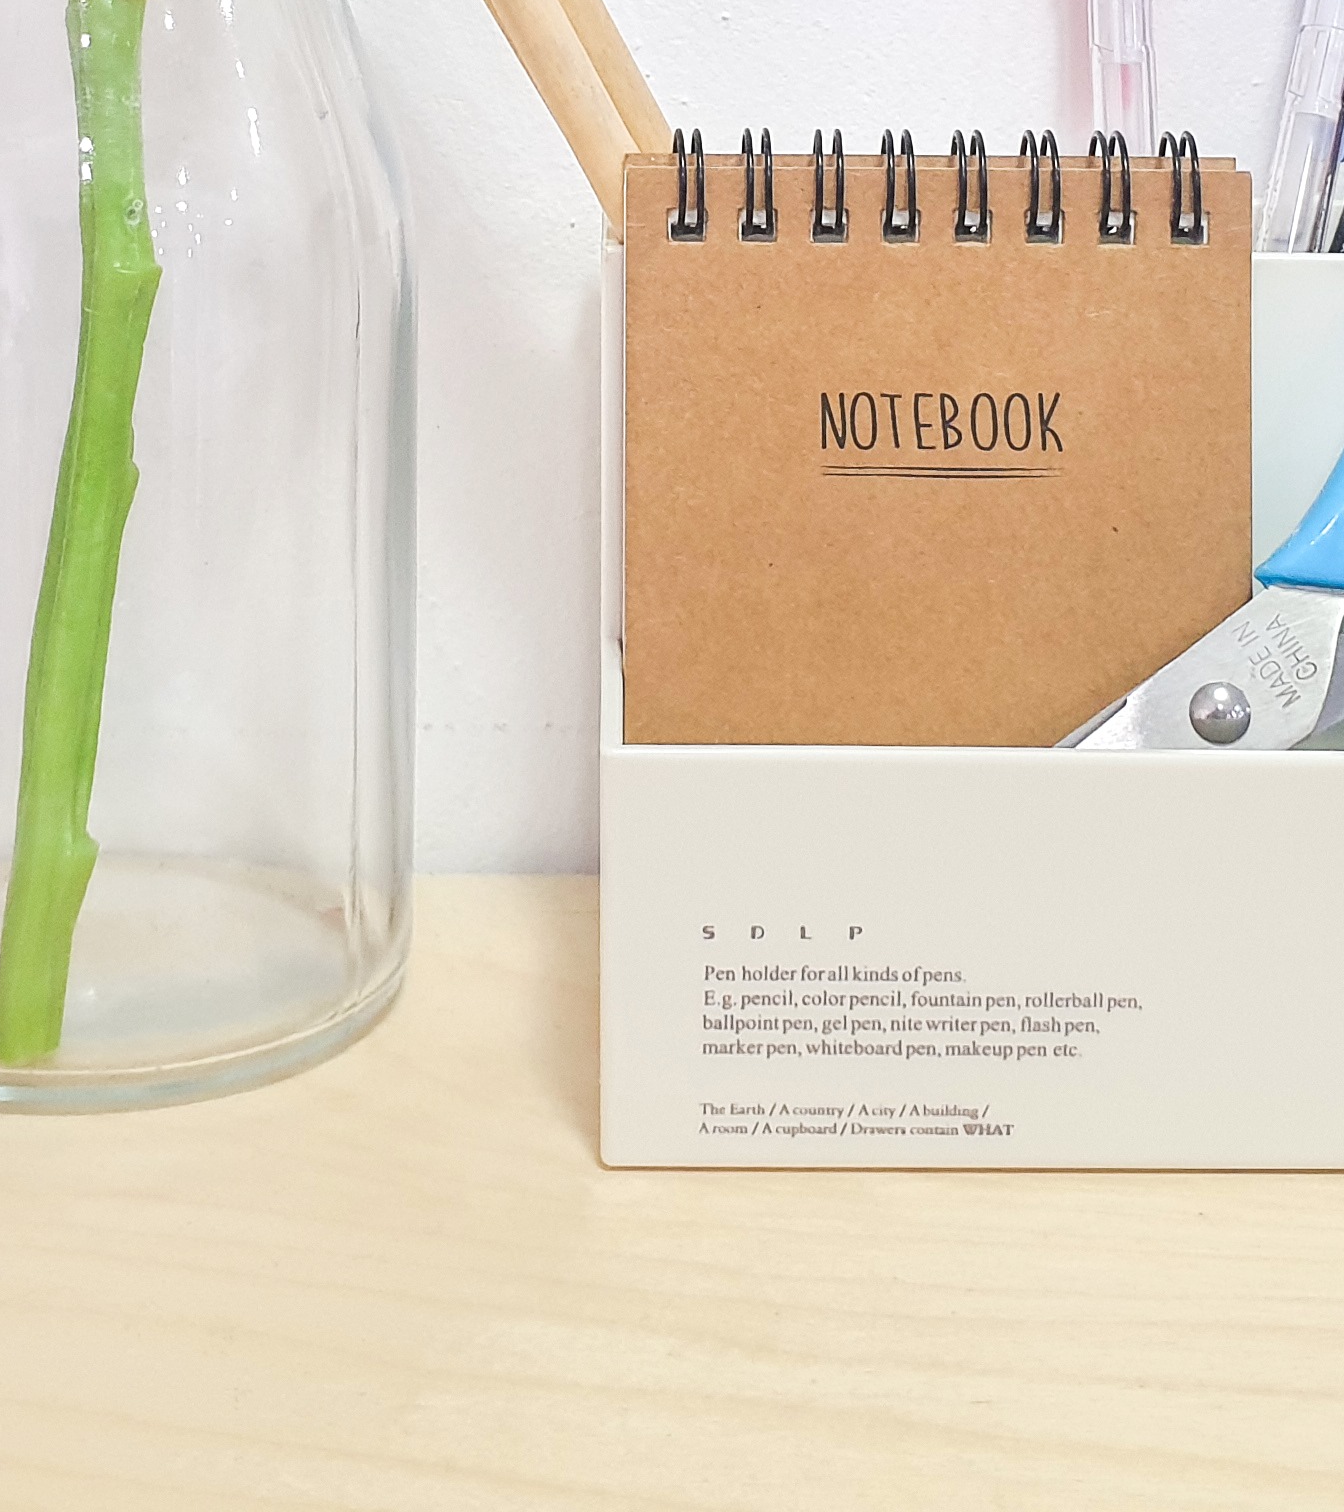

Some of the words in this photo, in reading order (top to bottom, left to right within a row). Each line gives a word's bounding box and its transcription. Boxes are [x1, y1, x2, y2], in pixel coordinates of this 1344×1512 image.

[820, 391, 1064, 453] NOTEBOOK
[1231, 620, 1261, 648] IN
[1264, 612, 1318, 681] CHINA
[1247, 644, 1302, 709] MADE
[703, 964, 736, 982] Pen
[741, 964, 798, 982] holder
[800, 964, 826, 982] for
[827, 965, 849, 982] all
[852, 965, 899, 983] kinds
[901, 965, 923, 983] of
[703, 989, 737, 1011] E.g.
[740, 989, 799, 1011] pencil,
[801, 989, 847, 1007] color
[849, 989, 907, 1011] pencil,
[910, 990, 982, 1008] fountain
[985, 995, 1022, 1012] pen,
[1024, 991, 1104, 1009] rollerball
[1106, 996, 1143, 1013] pen,
[702, 1013, 780, 1035] ballpoint
[782, 1018, 819, 1035] pen,
[821, 1014, 848, 1036] gel
[850, 1019, 887, 1036] pen,
[890, 1014, 923, 1032] nite
[925, 1015, 978, 1033] writer
[979, 1020, 1016, 1037] pen,
[1020, 1015, 1062, 1033] flash
[1063, 1021, 1101, 1037] pen,
[702, 1038, 764, 1055] marker
[766, 1043, 803, 1060] pen,
[805, 1038, 903, 1057] whiteboard
[905, 1044, 942, 1061] pen,
[944, 1039, 1014, 1061] makeup
[1016, 1045, 1048, 1061] pen
[699, 1102, 726, 1116] The
[729, 1102, 766, 1116] Earth
[778, 1103, 791, 1116] A
[792, 1106, 845, 1120] country
[858, 1103, 870, 1117] A
[871, 1106, 897, 1120] city
[909, 1103, 921, 1117] A
[922, 1103, 979, 1121] building
[698, 1121, 710, 1135] A
[712, 1125, 749, 1135] room
[761, 1122, 773, 1135] A
[775, 1121, 838, 1139] cupboard
[850, 1122, 907, 1136] Drawers
[909, 1124, 959, 1136] contain
[962, 1122, 1015, 1136] WHAT
